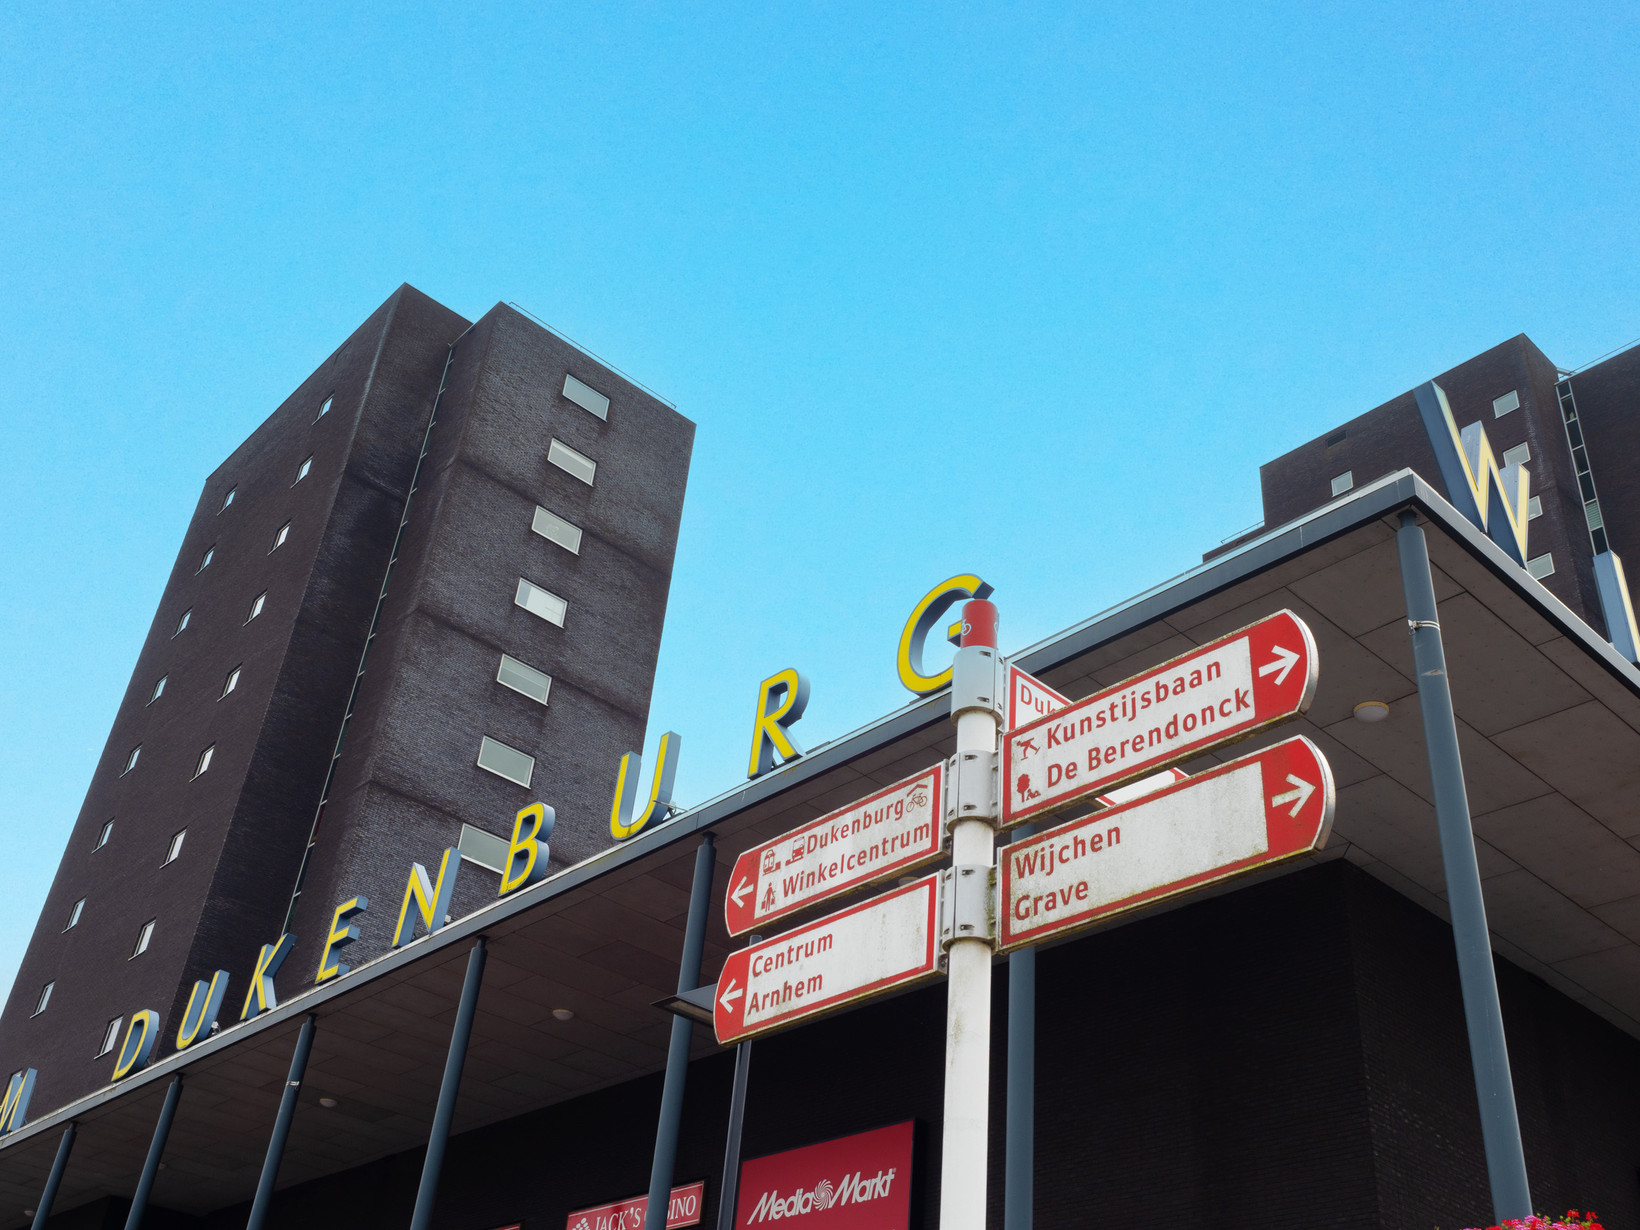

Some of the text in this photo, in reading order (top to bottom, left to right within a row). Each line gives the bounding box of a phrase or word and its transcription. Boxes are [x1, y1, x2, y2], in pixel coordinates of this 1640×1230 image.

[1046, 660, 1222, 750] Kunstijsbaan
[1046, 687, 1251, 789] De Berendonck
[111, 573, 994, 1082] DUKENBURG
[807, 798, 905, 855] Dukenburg
[1014, 825, 1121, 880] Wijchen
[782, 822, 930, 898] Winkelcentrum
[1014, 880, 1089, 922] Grave
[751, 933, 833, 978] Centrum
[747, 972, 823, 1016] Arnhem
[595, 1195, 697, 1230] JACK'S INO
